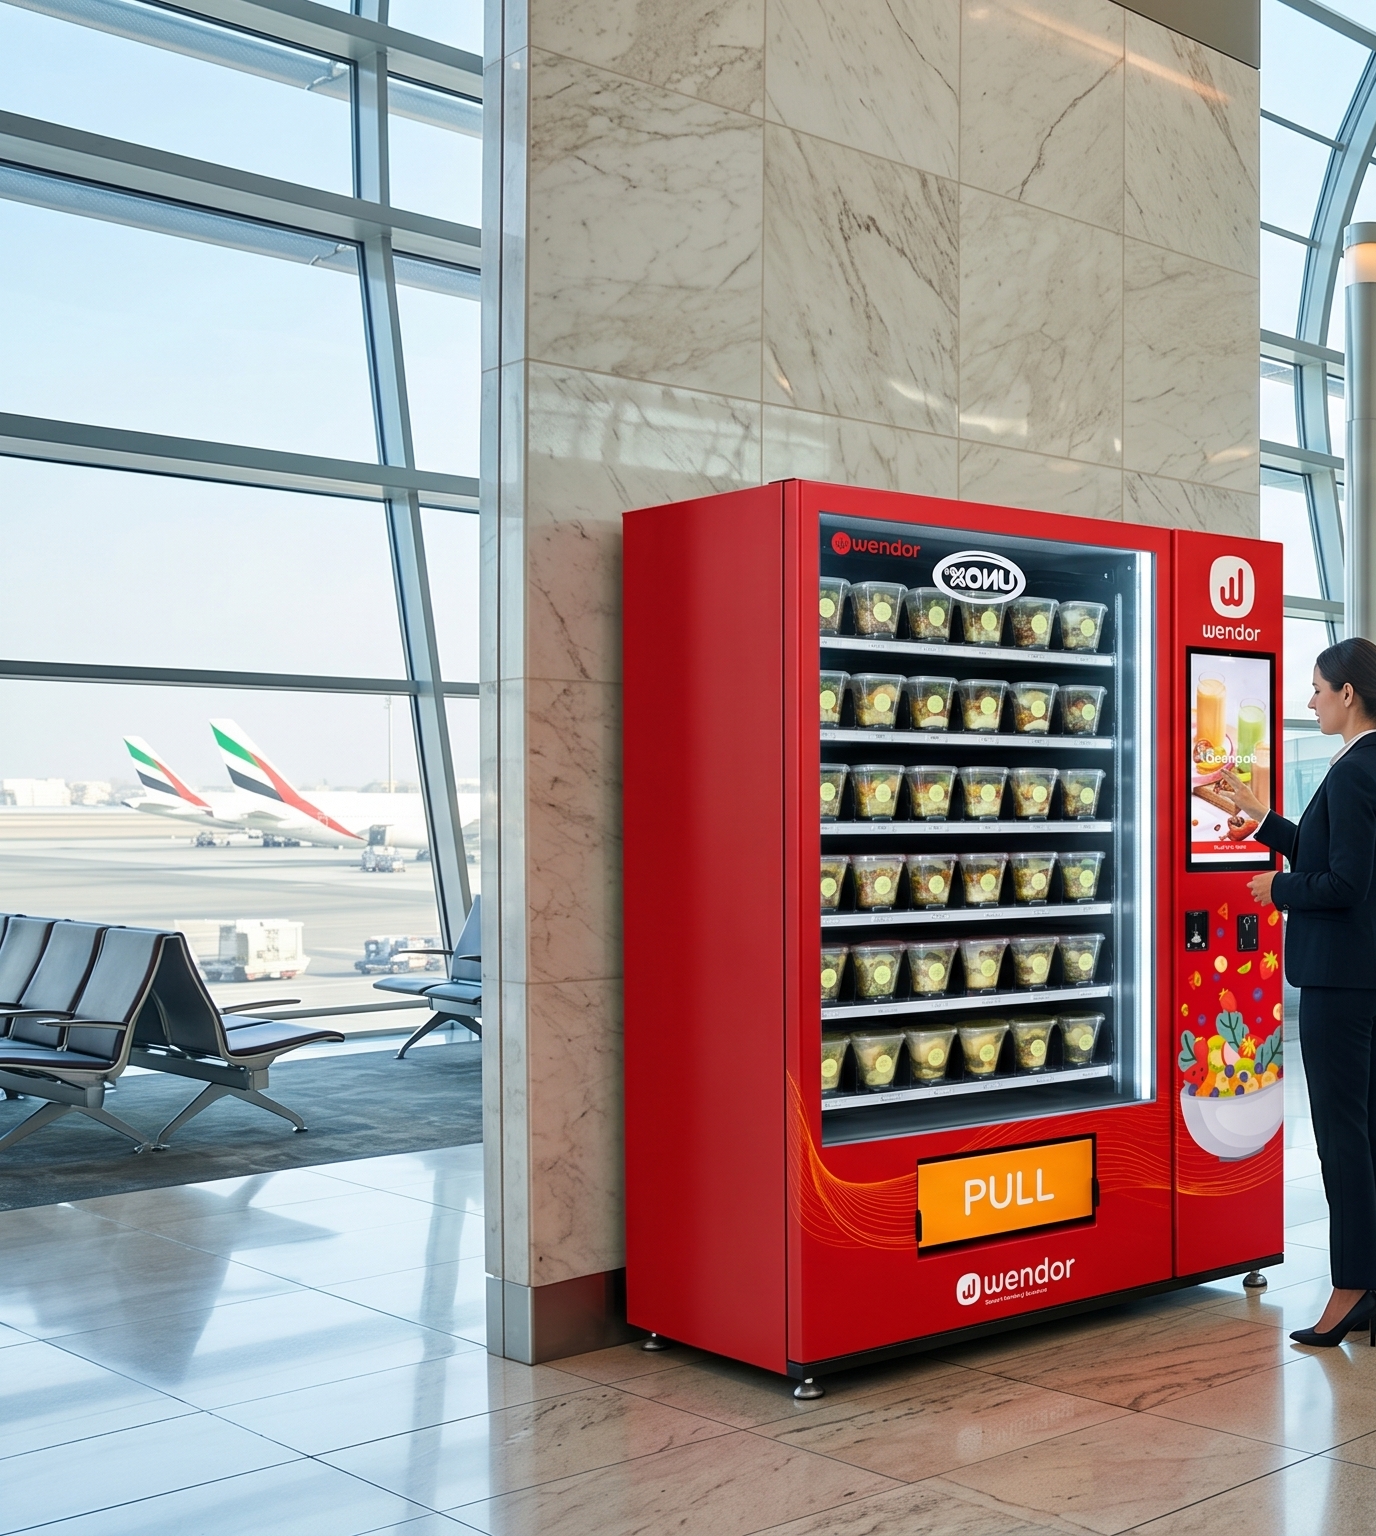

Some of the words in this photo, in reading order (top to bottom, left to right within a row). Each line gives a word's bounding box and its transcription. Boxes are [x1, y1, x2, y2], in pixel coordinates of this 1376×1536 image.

[852, 538, 921, 558] wendor
[1202, 623, 1261, 642] wendor
[963, 1167, 1055, 1217] PULL
[984, 1256, 1076, 1295] wendor
